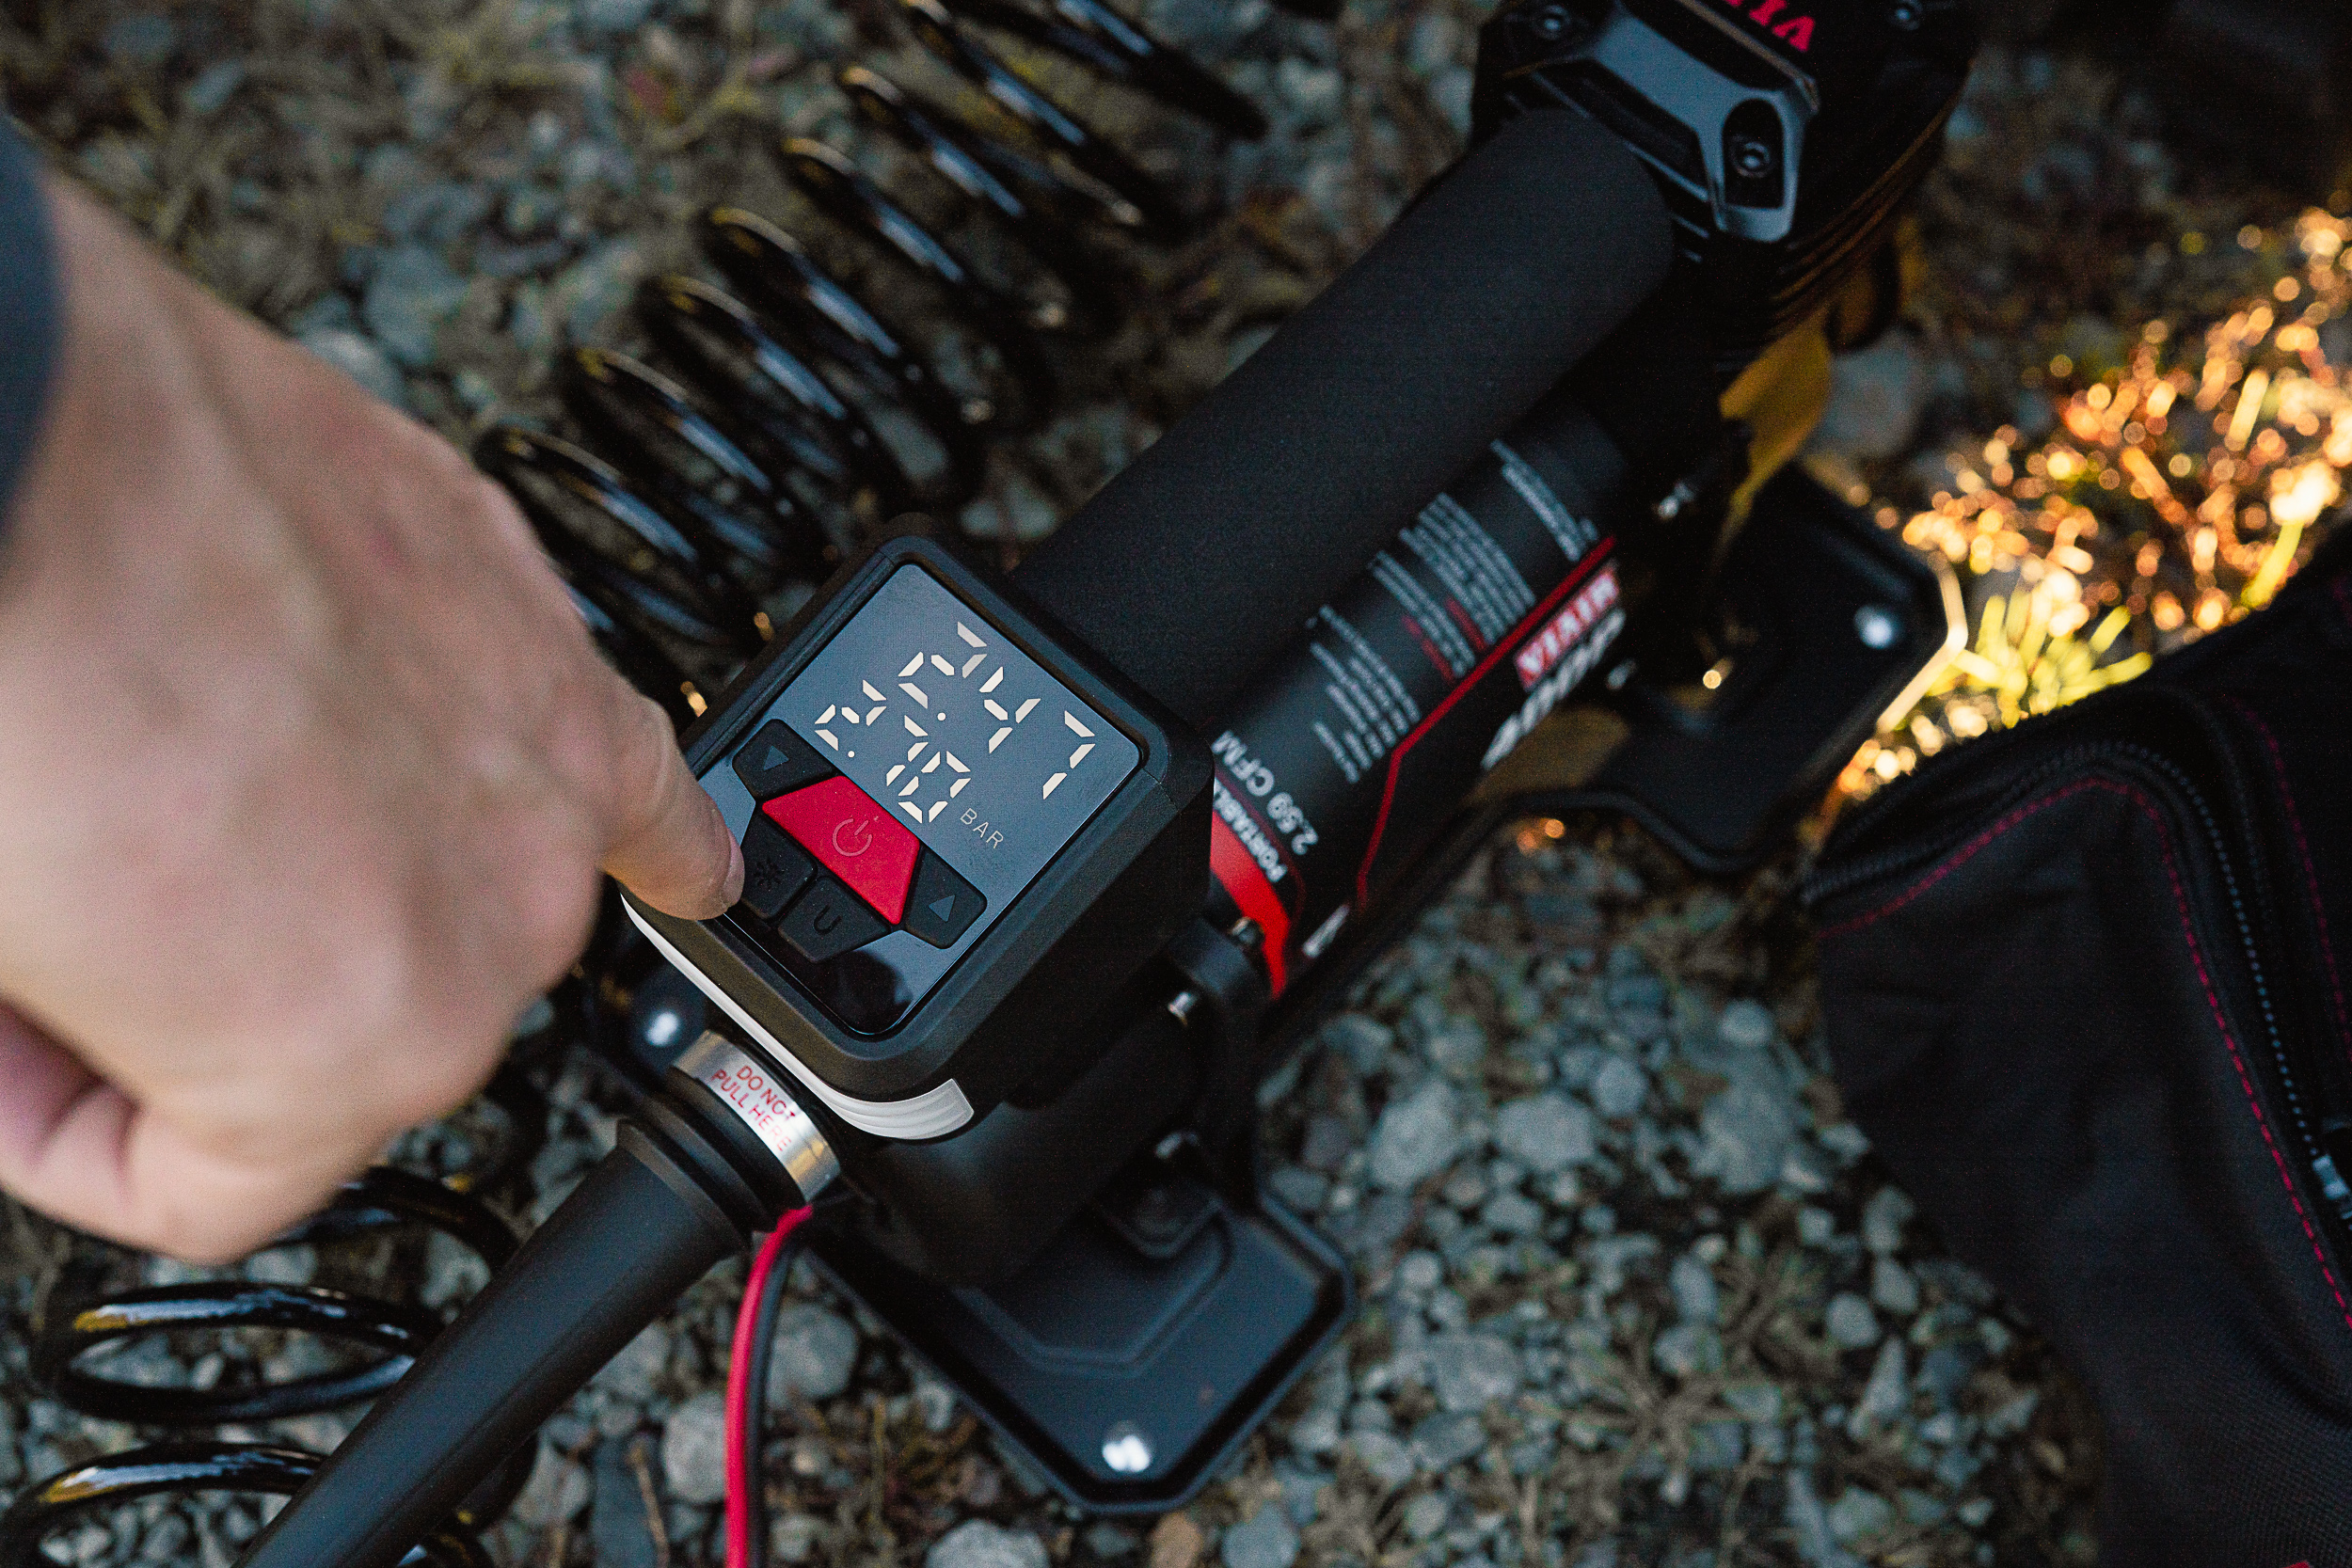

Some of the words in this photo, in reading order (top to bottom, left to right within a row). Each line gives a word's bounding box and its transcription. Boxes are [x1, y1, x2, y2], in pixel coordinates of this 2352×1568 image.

[1725, 0, 1816, 52] VI
[1517, 570, 1619, 674] VIAIR
[898, 621, 1096, 800] 2.47
[813, 679, 972, 824] 2.70
[959, 806, 1005, 849] BAR
[1211, 730, 1275, 797] CFM
[710, 1069, 750, 1108] PULL
[748, 1103, 792, 1152] HERE
[736, 1065, 764, 1091] DO
